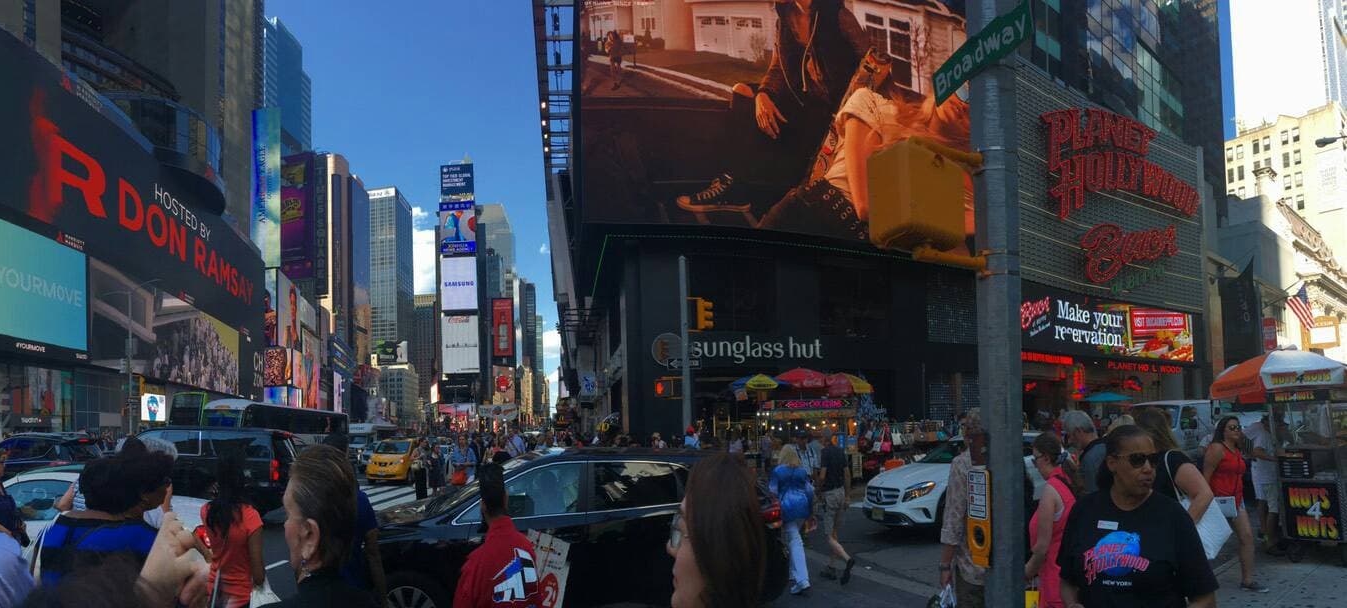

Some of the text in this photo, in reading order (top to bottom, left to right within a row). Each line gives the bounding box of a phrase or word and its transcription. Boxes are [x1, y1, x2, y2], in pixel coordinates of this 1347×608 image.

[935, 13, 1026, 97] Broadway
[1040, 107, 1158, 171] PLANET
[1048, 151, 1201, 222] HOLLYWOOD
[154, 183, 212, 242] HOSTED BY
[118, 176, 187, 262] DON
[194, 235, 254, 306] RAMSAY
[1057, 300, 1124, 330] Make your
[15, 341, 46, 353] #YOURMOVE
[692, 335, 823, 364] sunglass hut
[1107, 361, 1137, 372] PLANET
[1271, 372, 1296, 385] NUTS
[1303, 369, 1331, 382] NUTS
[1289, 487, 1331, 510] NUTS
[1306, 501, 1323, 521] 4
[1296, 515, 1339, 540] NUTS
[1084, 543, 1128, 572] PLANET
[1085, 553, 1150, 586] HOLLYWOOD
